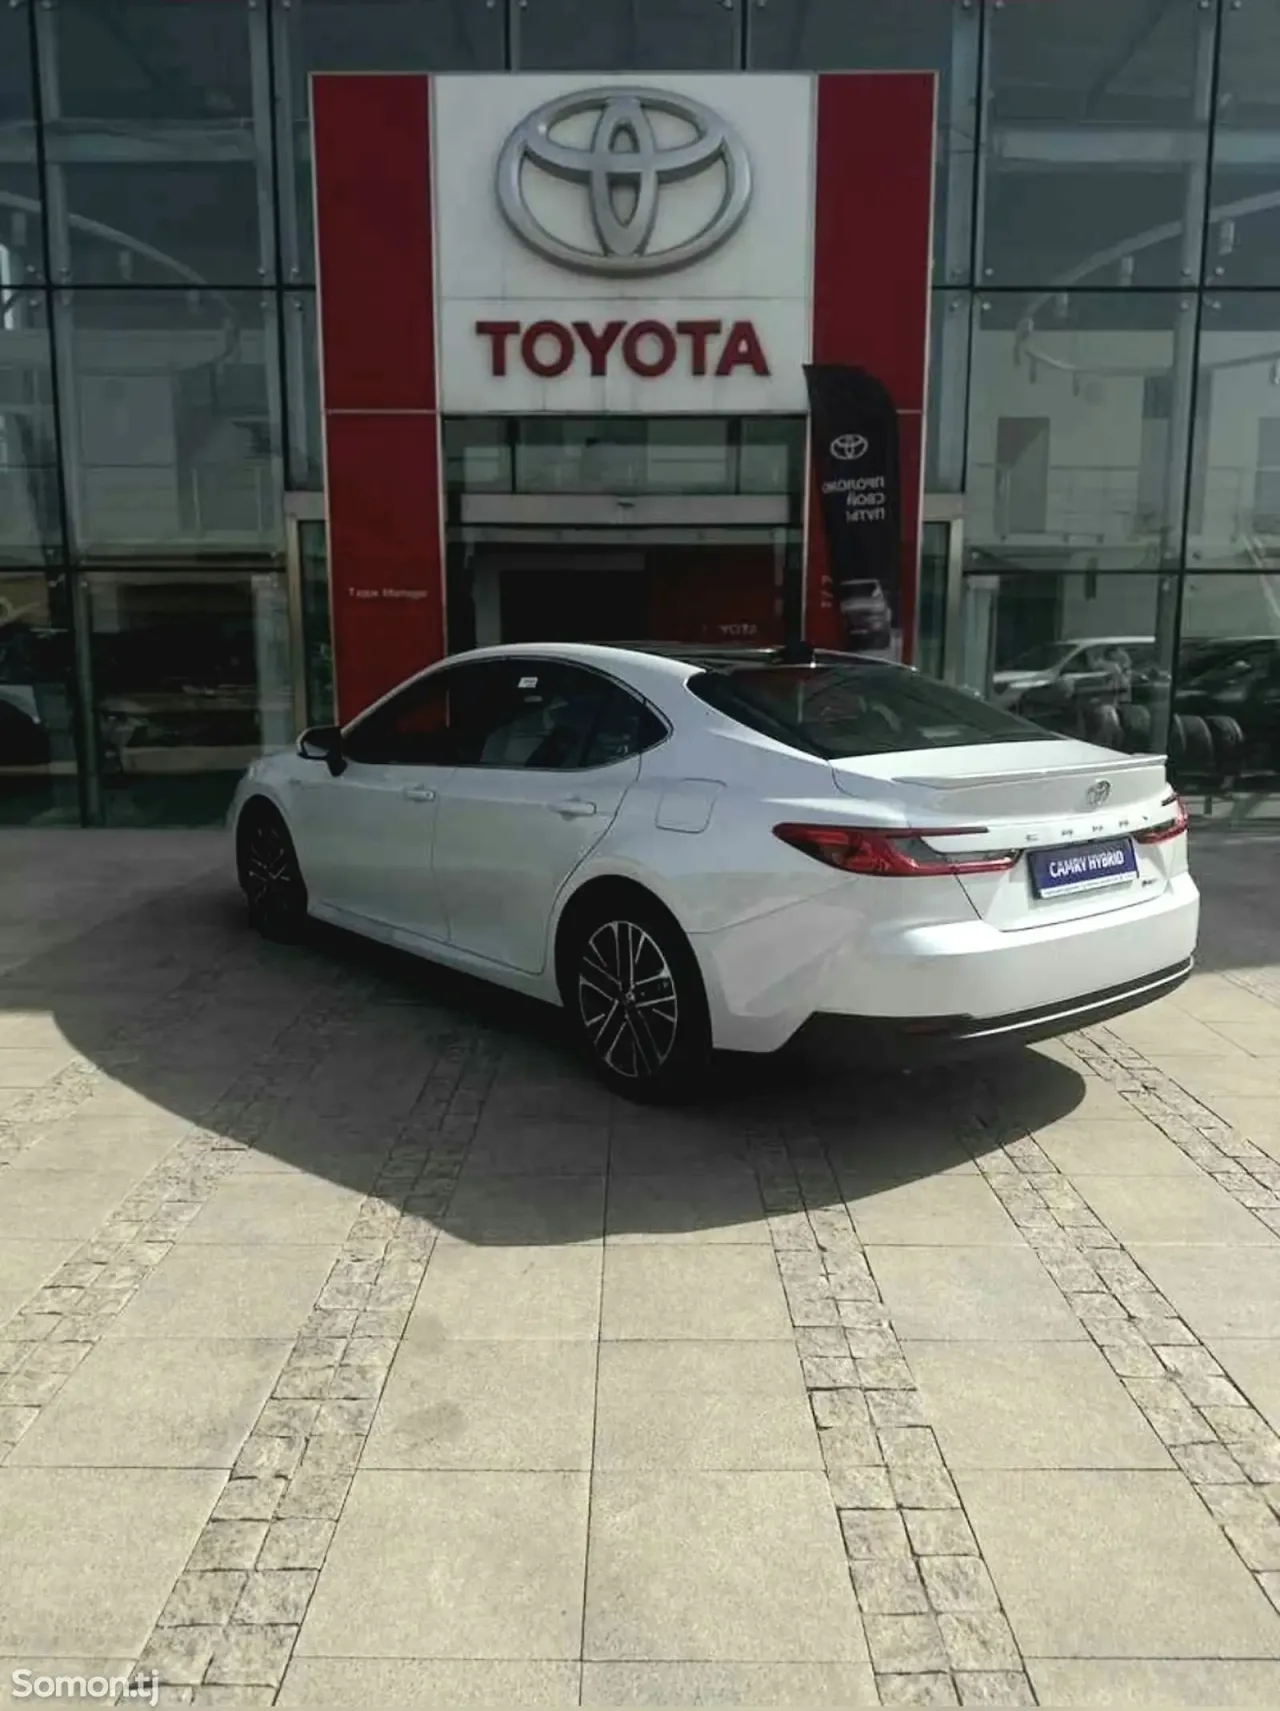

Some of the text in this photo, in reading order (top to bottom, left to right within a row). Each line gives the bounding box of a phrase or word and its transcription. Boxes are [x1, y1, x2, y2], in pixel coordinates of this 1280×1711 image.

[475, 320, 771, 377] TOYOTA
[1049, 850, 1124, 878] CAMRY HYBRID
